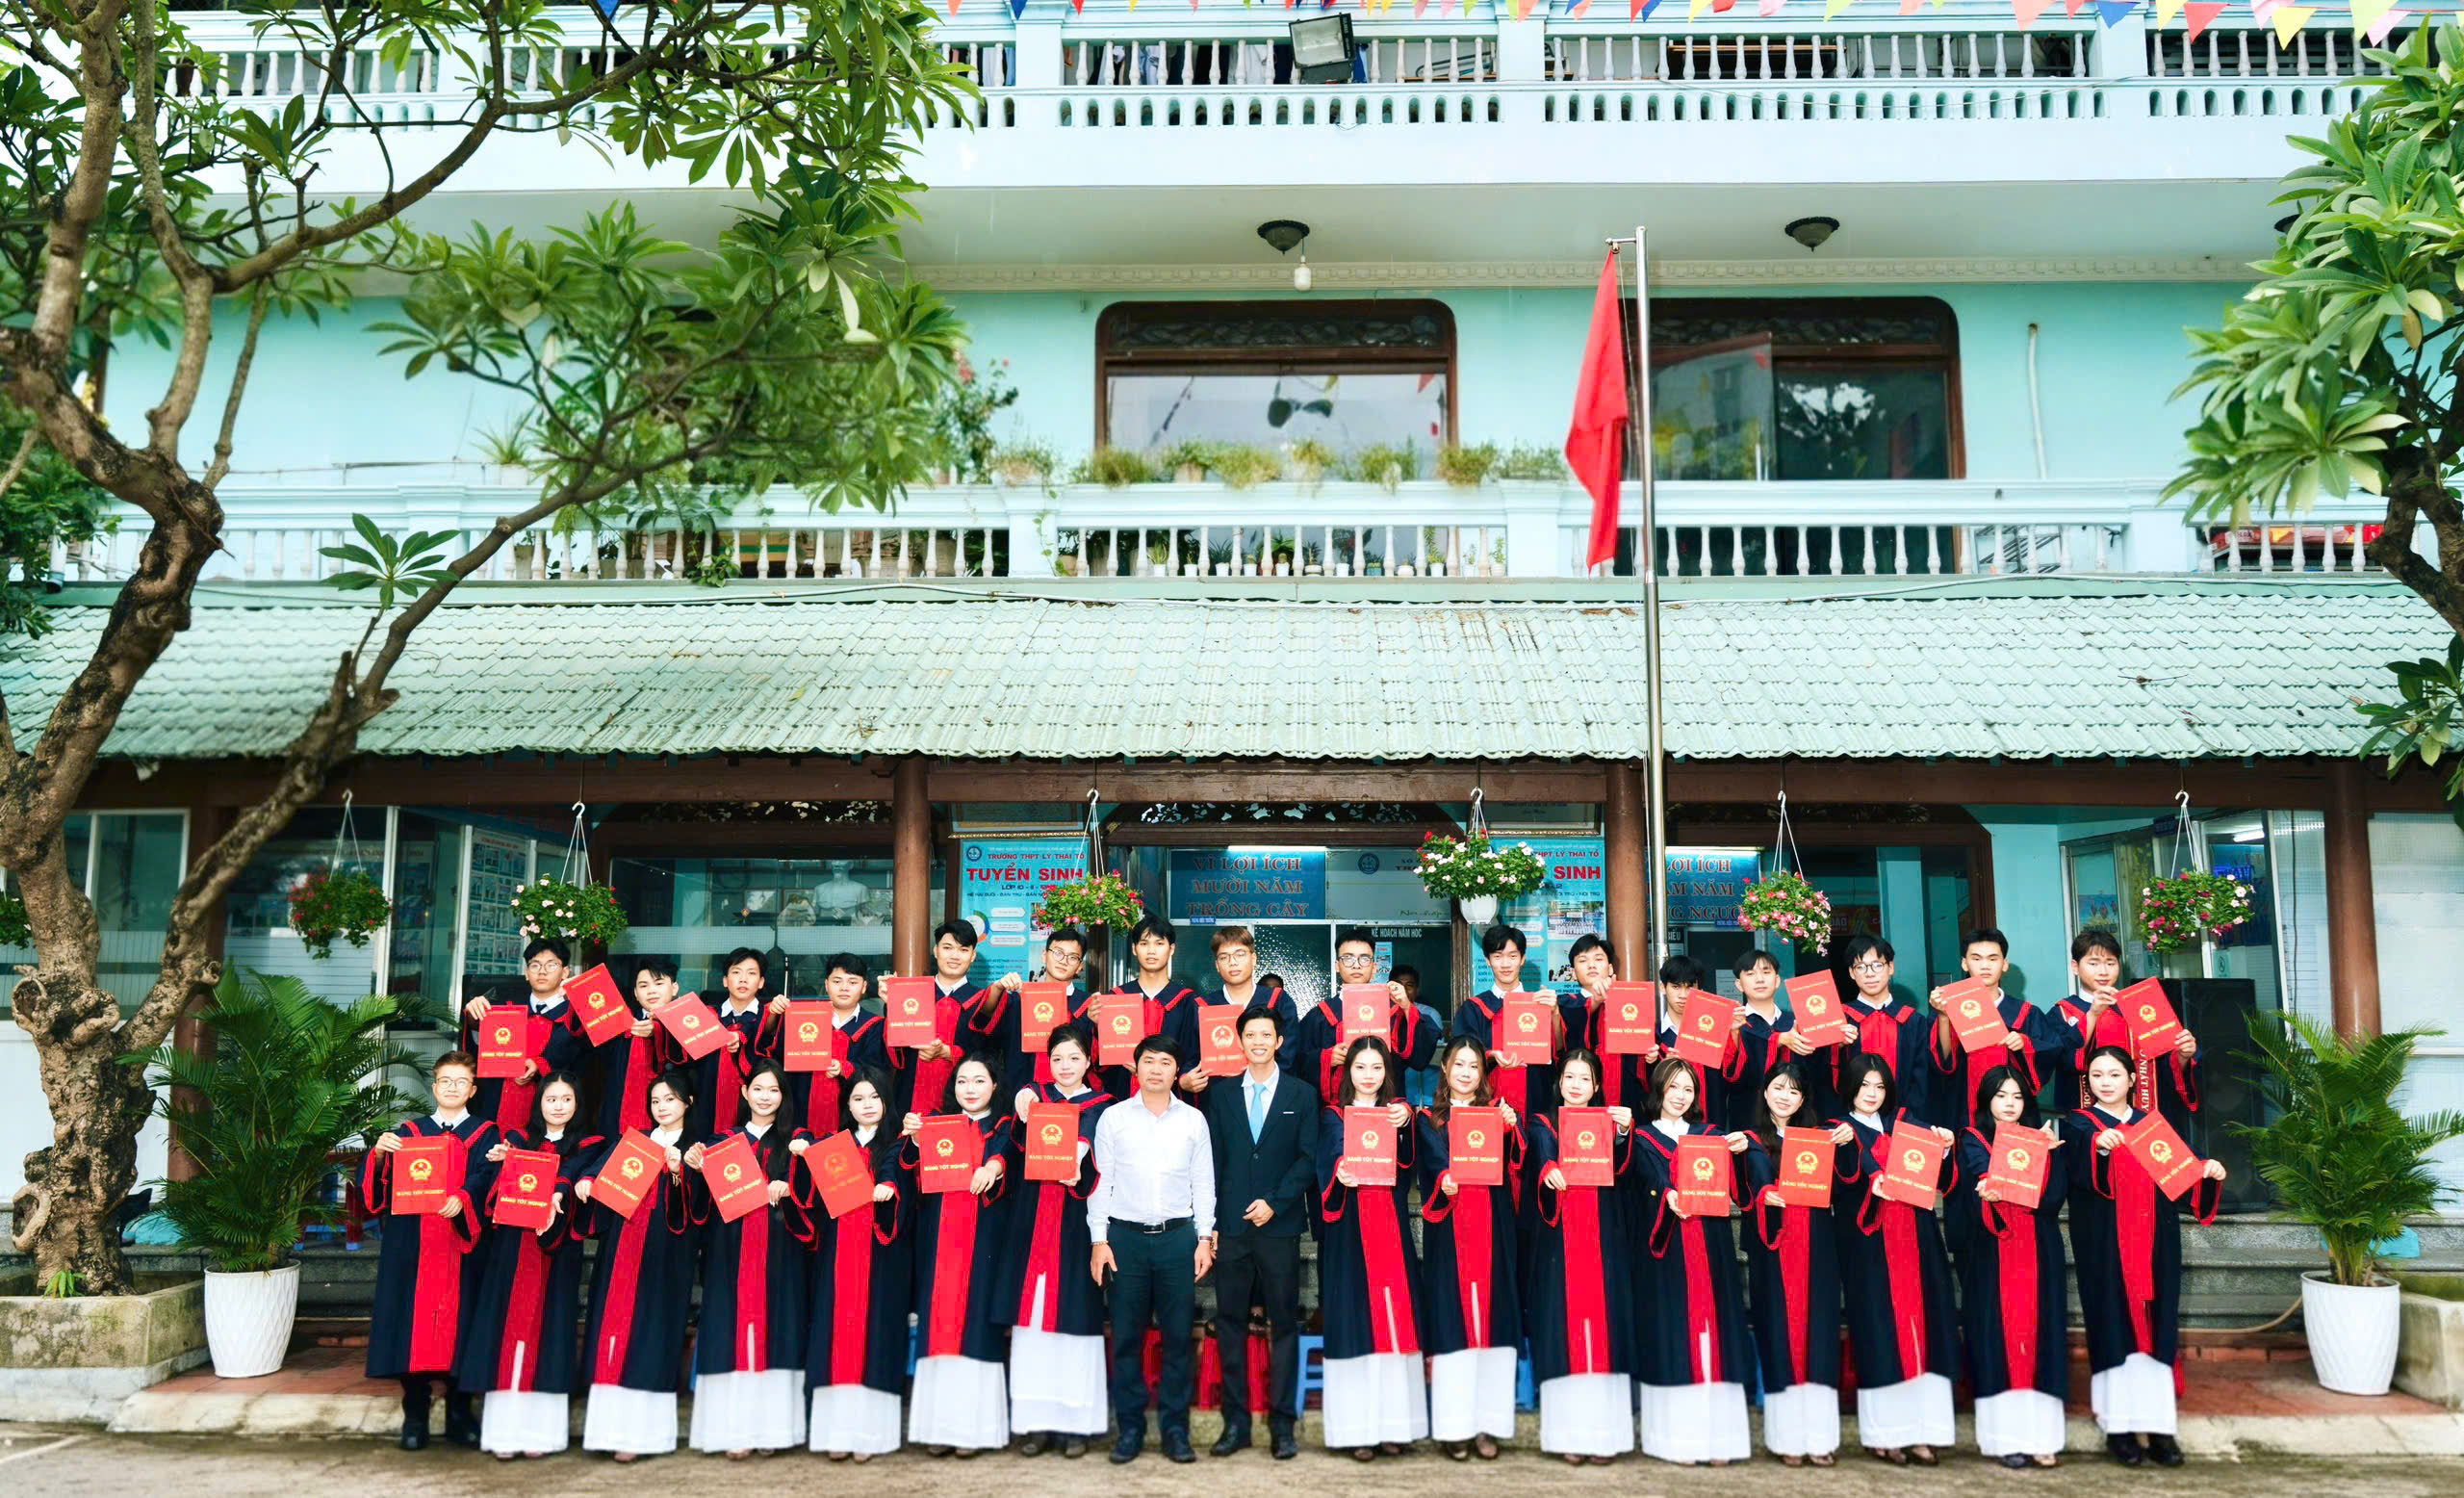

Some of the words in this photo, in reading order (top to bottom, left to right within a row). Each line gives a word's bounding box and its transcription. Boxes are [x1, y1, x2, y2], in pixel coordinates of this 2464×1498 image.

[966, 863, 1030, 881] TUYỂN
[1040, 867, 1083, 881] SINH
[1221, 856, 1257, 874] LỢI
[1263, 854, 1301, 871] ÍCH
[1554, 865, 1601, 880] SINH
[1667, 856, 1694, 876] ỢI
[1697, 855, 1732, 872] ÍCH
[1193, 876, 1248, 893] MƯỜI
[1255, 876, 1302, 893] NĂM
[1693, 877, 1734, 895] NĂM
[1186, 898, 1261, 917] TRỒNG
[1267, 899, 1309, 917] CÂY
[1689, 902, 1740, 919] NGƯỜ
[1399, 926, 1410, 938] NĂM
[2141, 1088, 2149, 1111] HUY
